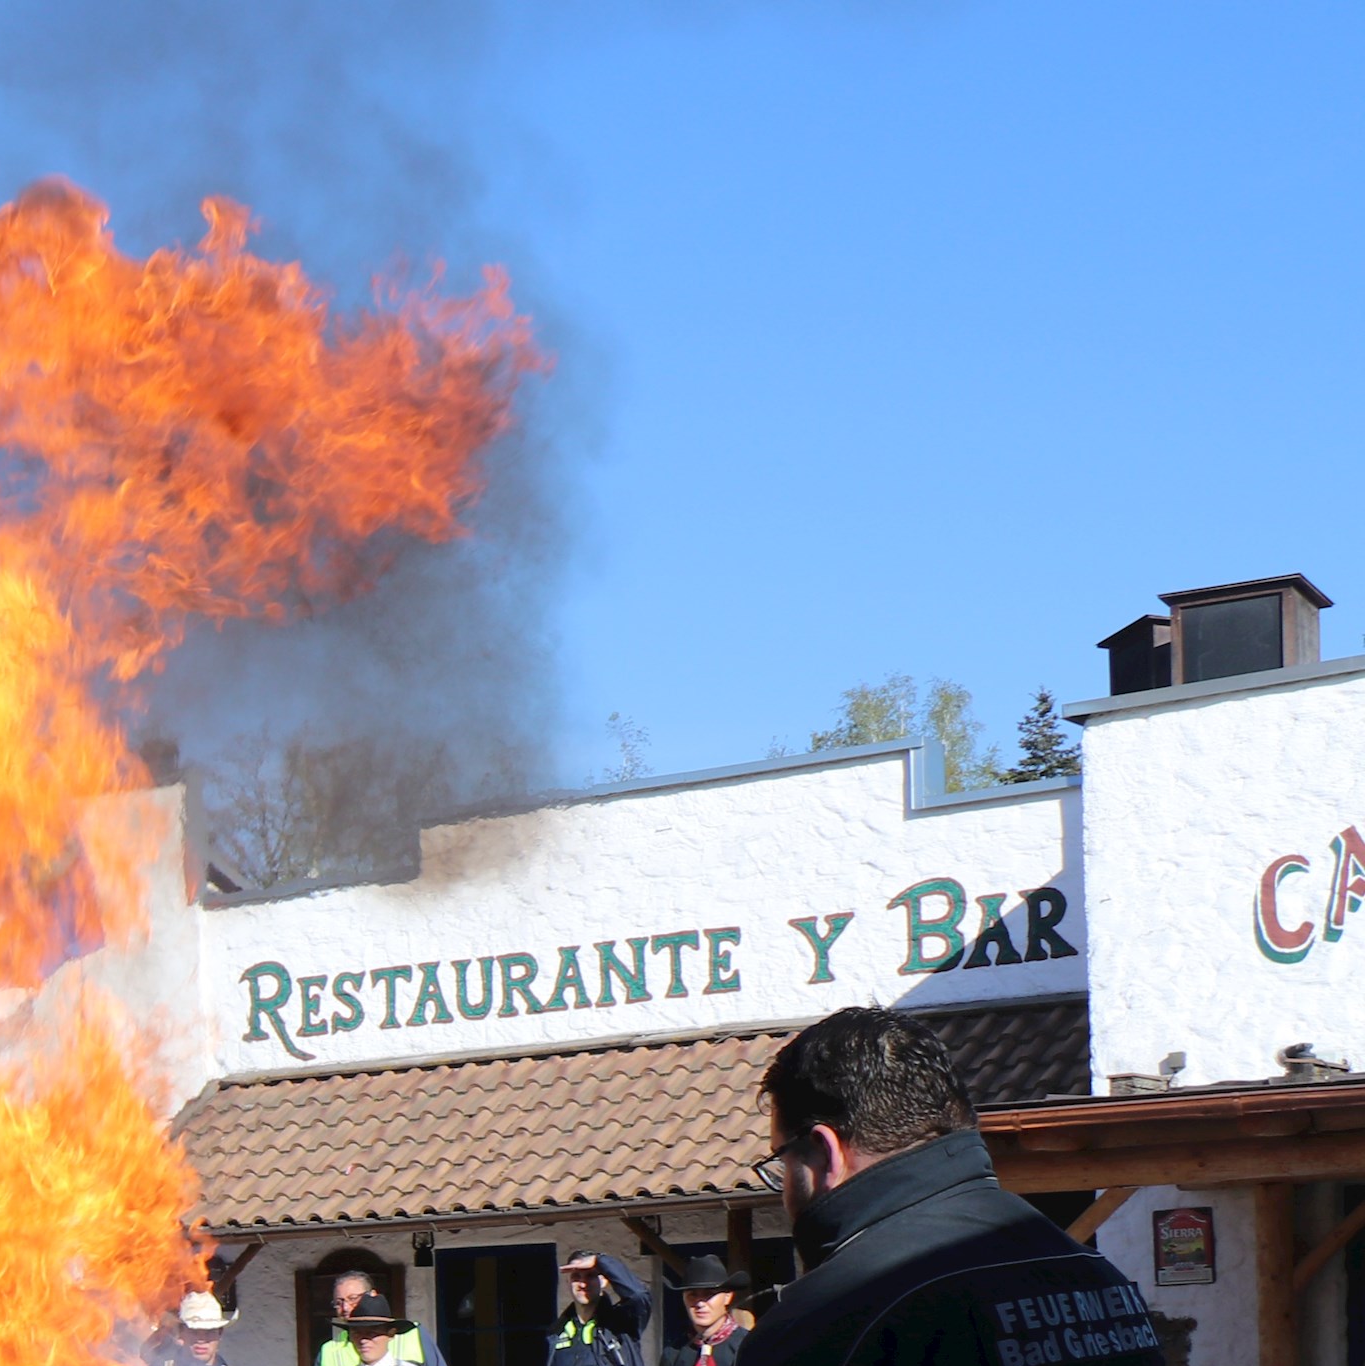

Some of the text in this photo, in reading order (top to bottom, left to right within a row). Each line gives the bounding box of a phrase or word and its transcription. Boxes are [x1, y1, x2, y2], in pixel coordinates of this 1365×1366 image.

[239, 876, 1078, 1061] RESTAURANTE Y BAR
[1160, 1227, 1204, 1240] SIERRA
